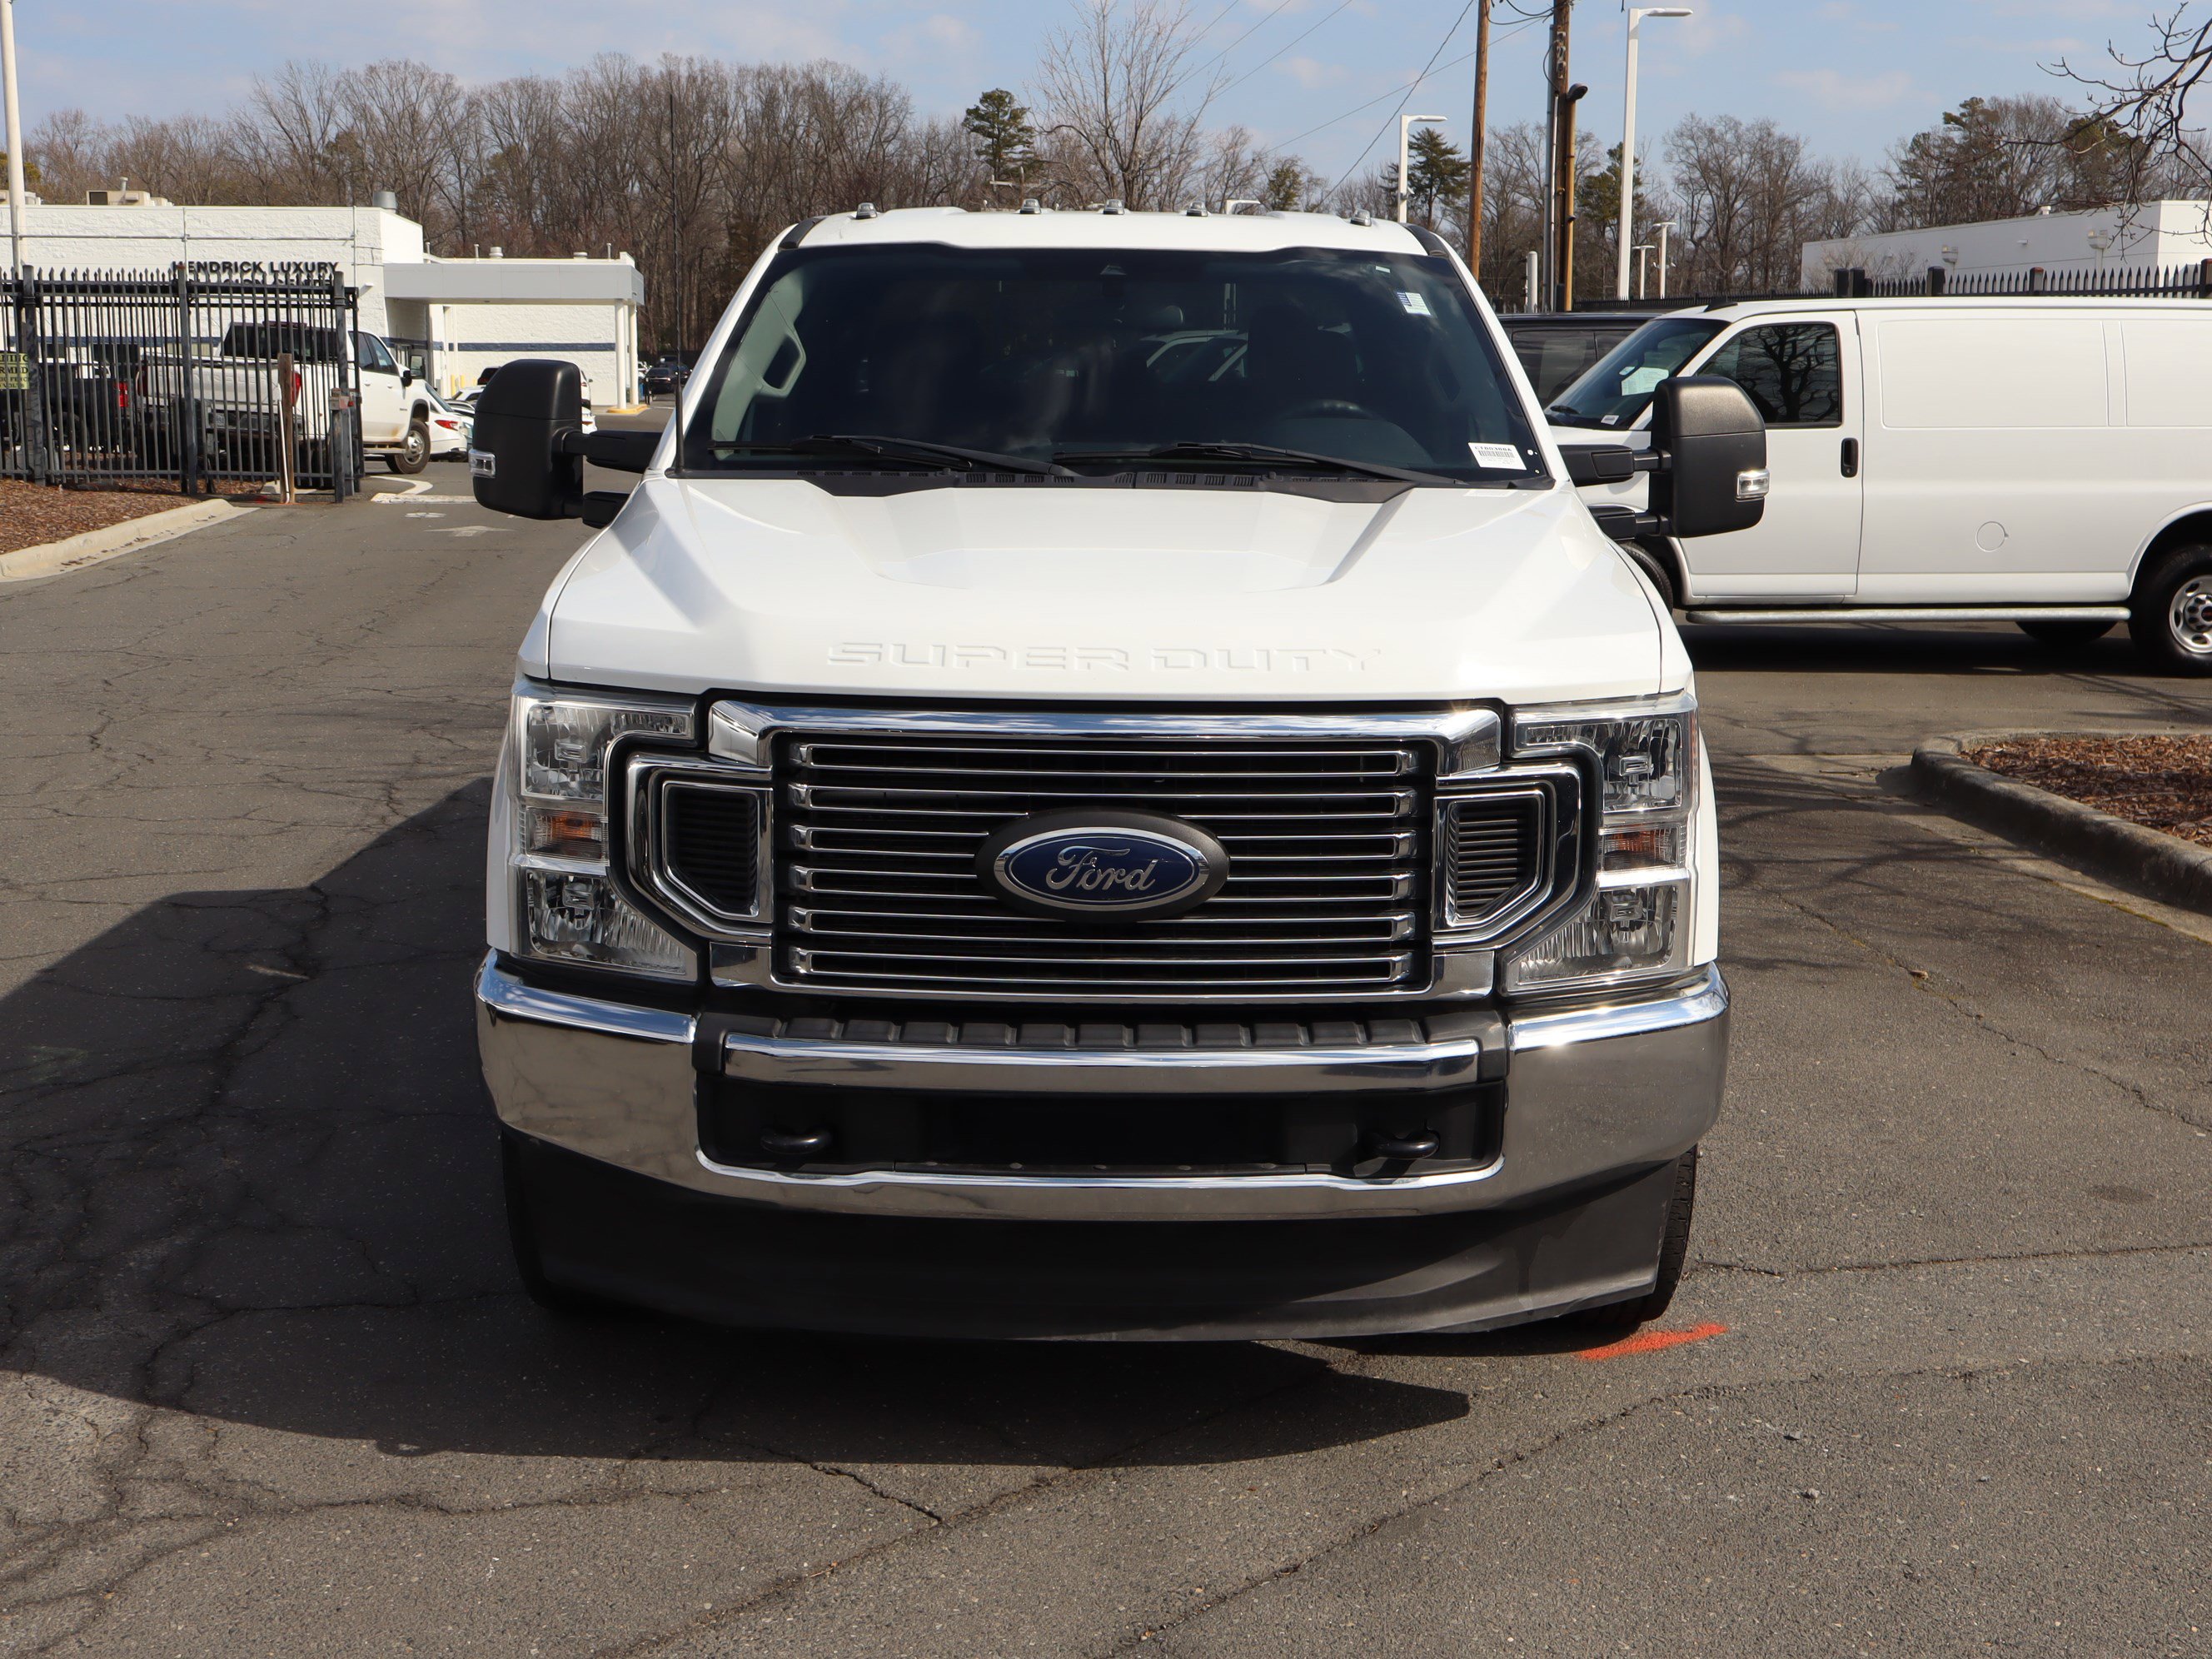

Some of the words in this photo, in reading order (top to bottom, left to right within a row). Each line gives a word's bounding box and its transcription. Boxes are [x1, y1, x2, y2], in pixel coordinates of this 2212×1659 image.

[172, 261, 263, 273] HENDRICK
[269, 261, 339, 273] LUXURY
[828, 642, 1129, 671] SUPER
[1150, 648, 1381, 671] DUTY
[1045, 845, 1156, 891] Ford
